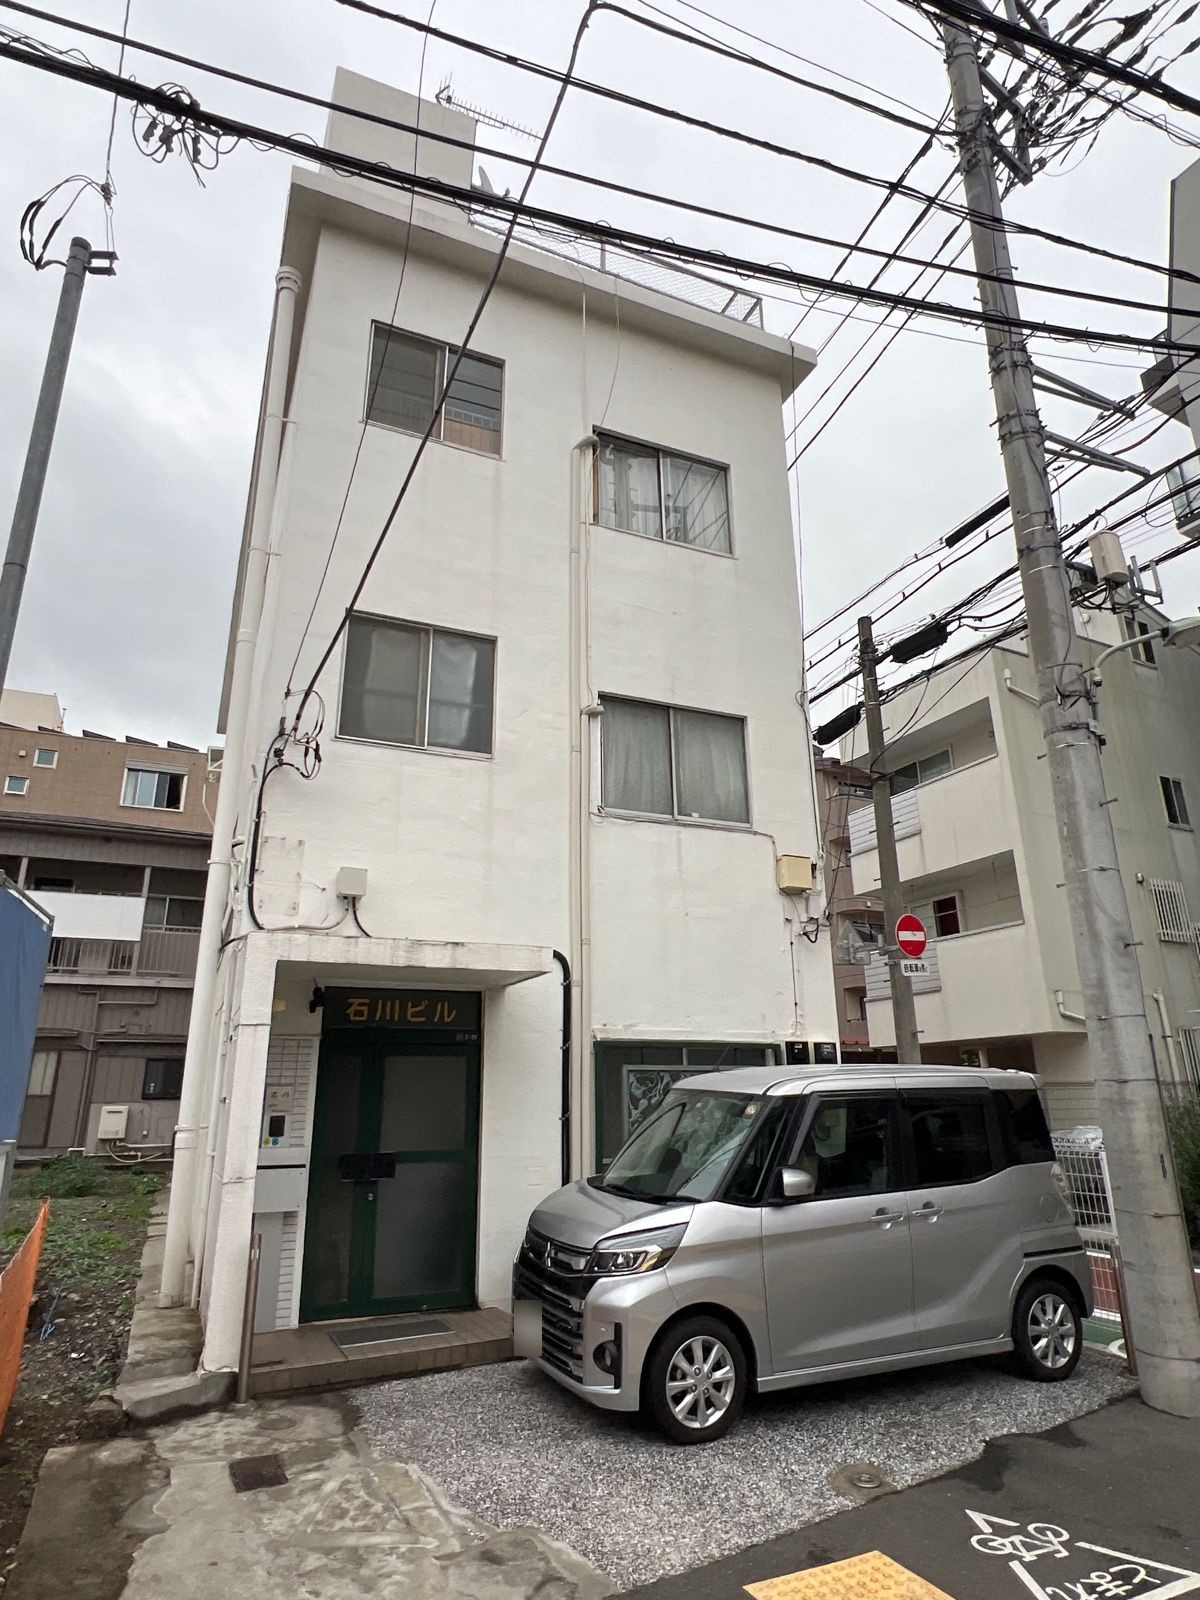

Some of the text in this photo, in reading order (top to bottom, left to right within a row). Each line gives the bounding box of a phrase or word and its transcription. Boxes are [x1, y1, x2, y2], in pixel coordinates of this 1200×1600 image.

[346, 998, 457, 1022] 石川ビル
[1044, 1564, 1161, 1600] とまれ
